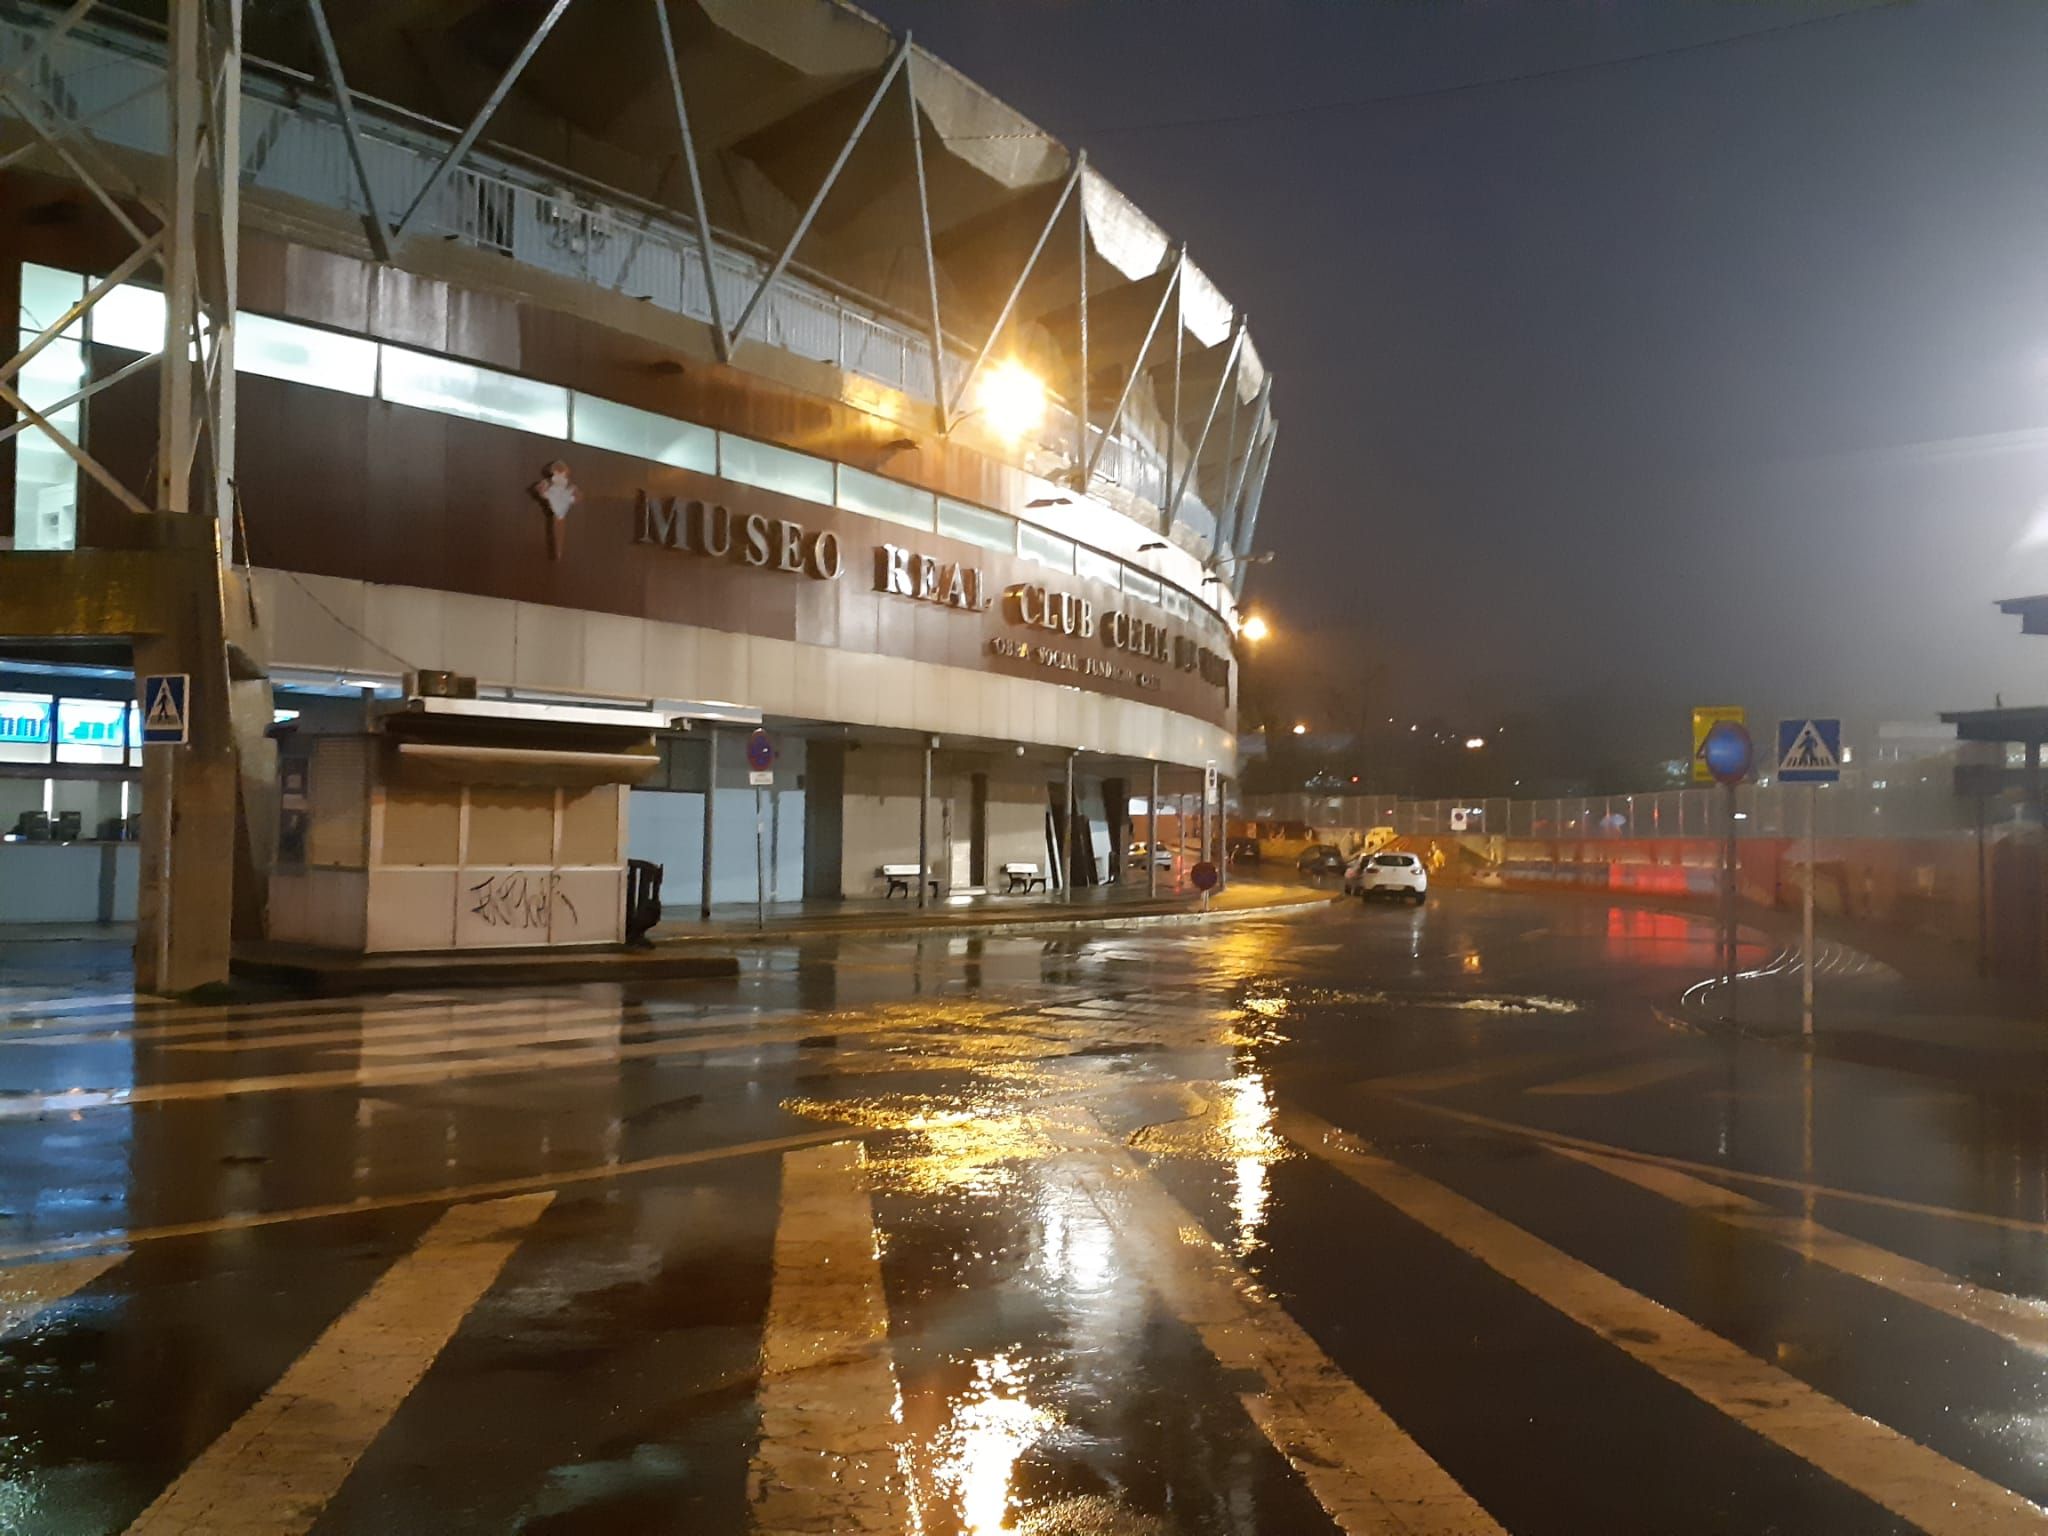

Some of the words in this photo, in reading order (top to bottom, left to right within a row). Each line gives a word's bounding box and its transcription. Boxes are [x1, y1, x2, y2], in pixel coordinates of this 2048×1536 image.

[637, 489, 846, 580] MUSEO
[875, 543, 992, 610] REAL
[1008, 583, 1094, 638] CLUB
[1037, 647, 1080, 673] SOCIAL
